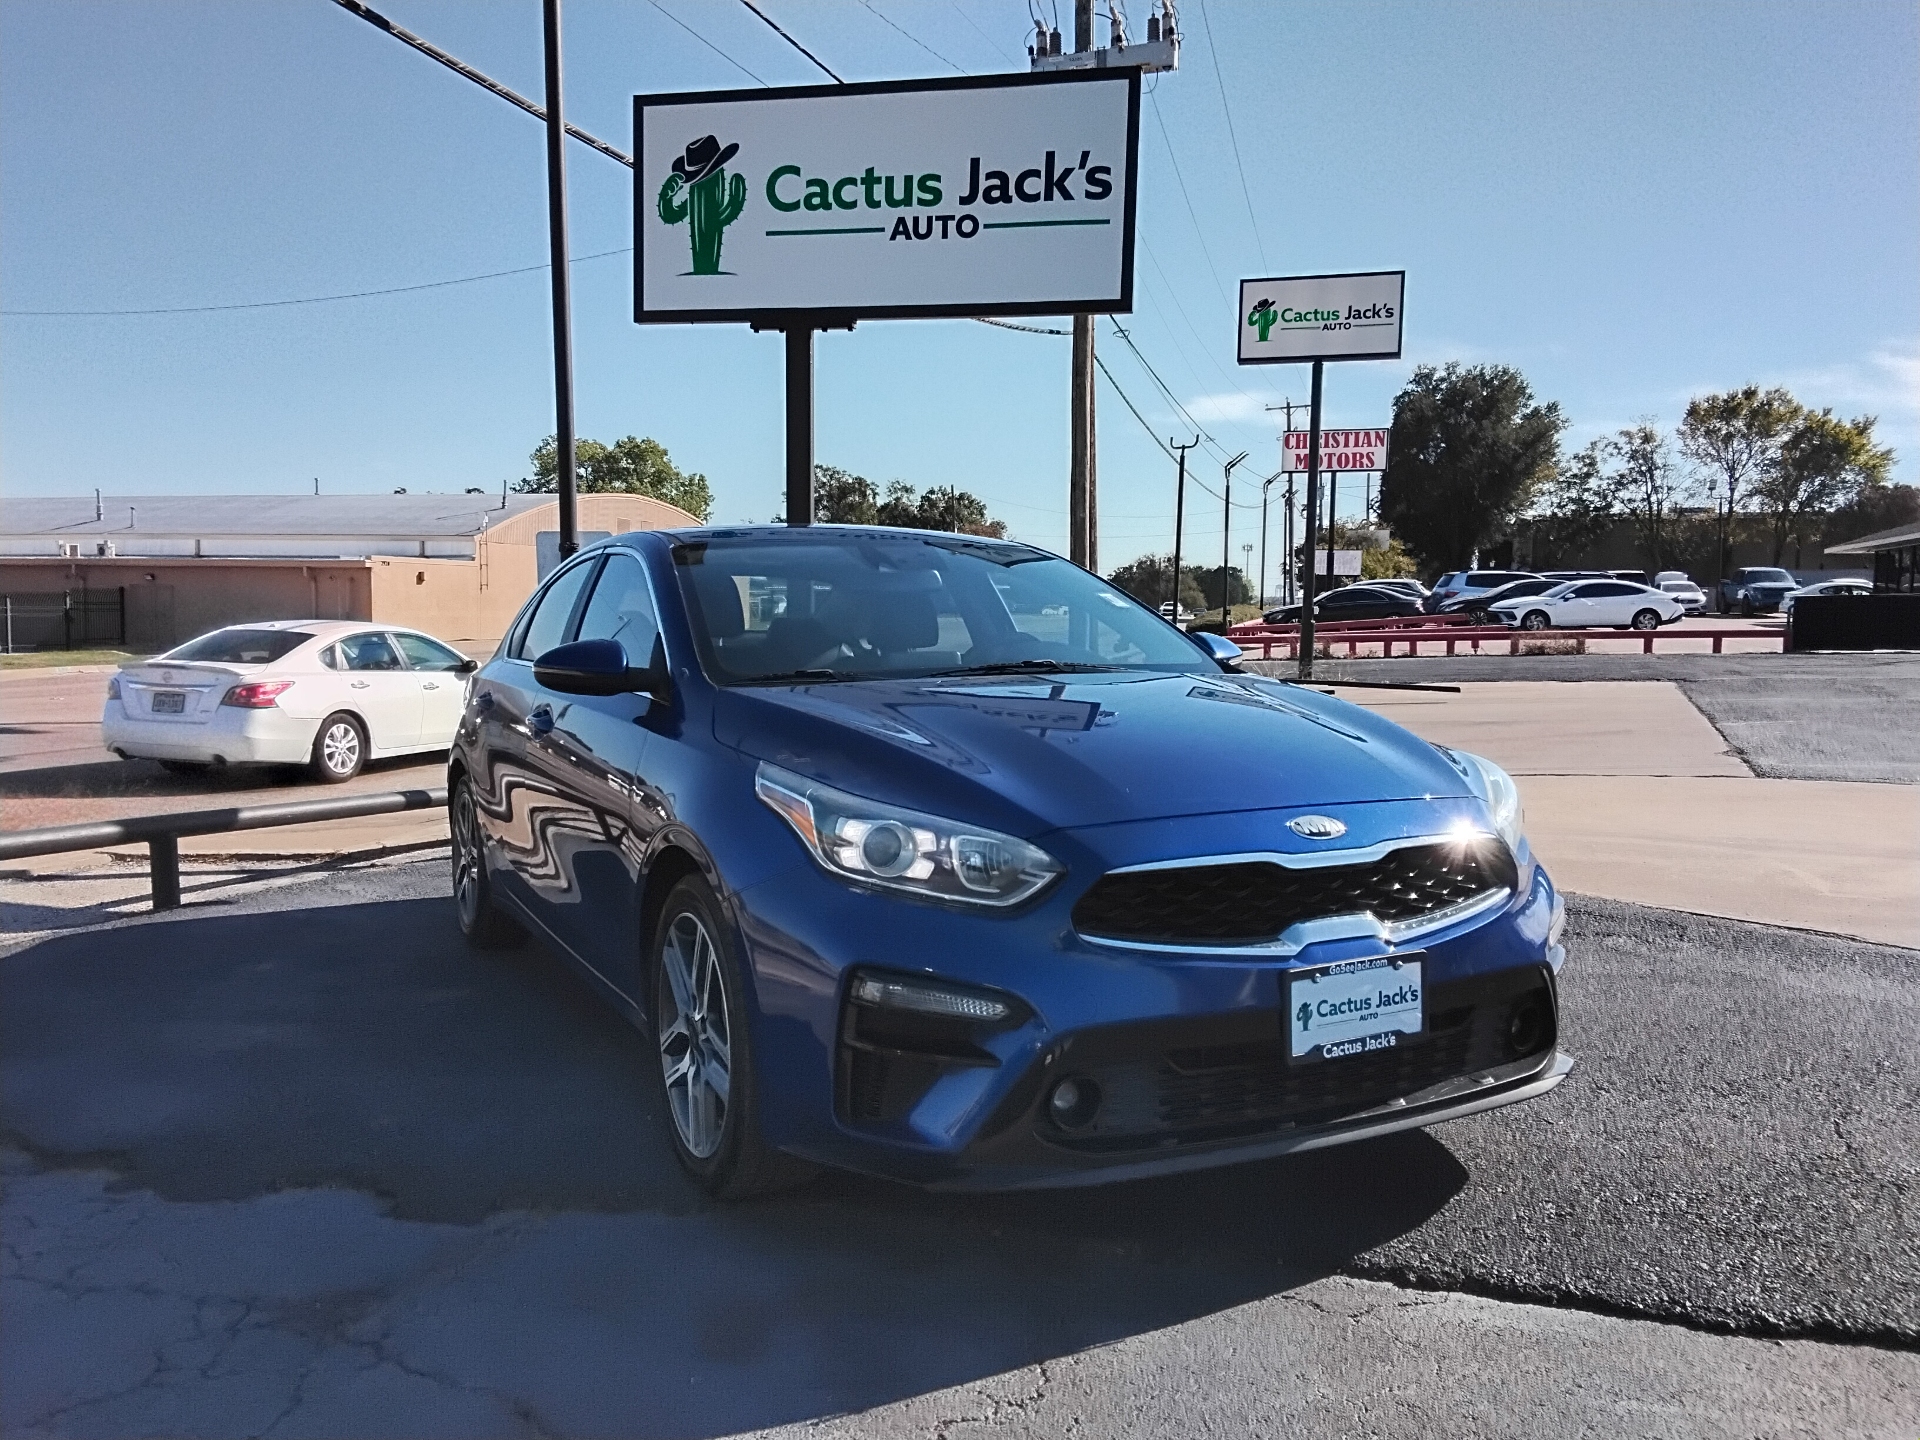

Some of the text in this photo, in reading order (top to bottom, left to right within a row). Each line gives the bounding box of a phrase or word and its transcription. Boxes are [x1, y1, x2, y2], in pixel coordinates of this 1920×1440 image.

[765, 150, 1113, 213] Cactus Jack's
[889, 213, 980, 241] AUTO
[1281, 303, 1394, 323] Cactus Jack's
[1321, 322, 1352, 331] AUTO
[1284, 430, 1386, 450] CHISTIAN
[1329, 958, 1388, 975] GoSeeJack.com
[1316, 984, 1419, 1018] Cactus Jack's
[1358, 1012, 1379, 1022] AUTO
[1323, 1032, 1396, 1059] Cactus Jack's
